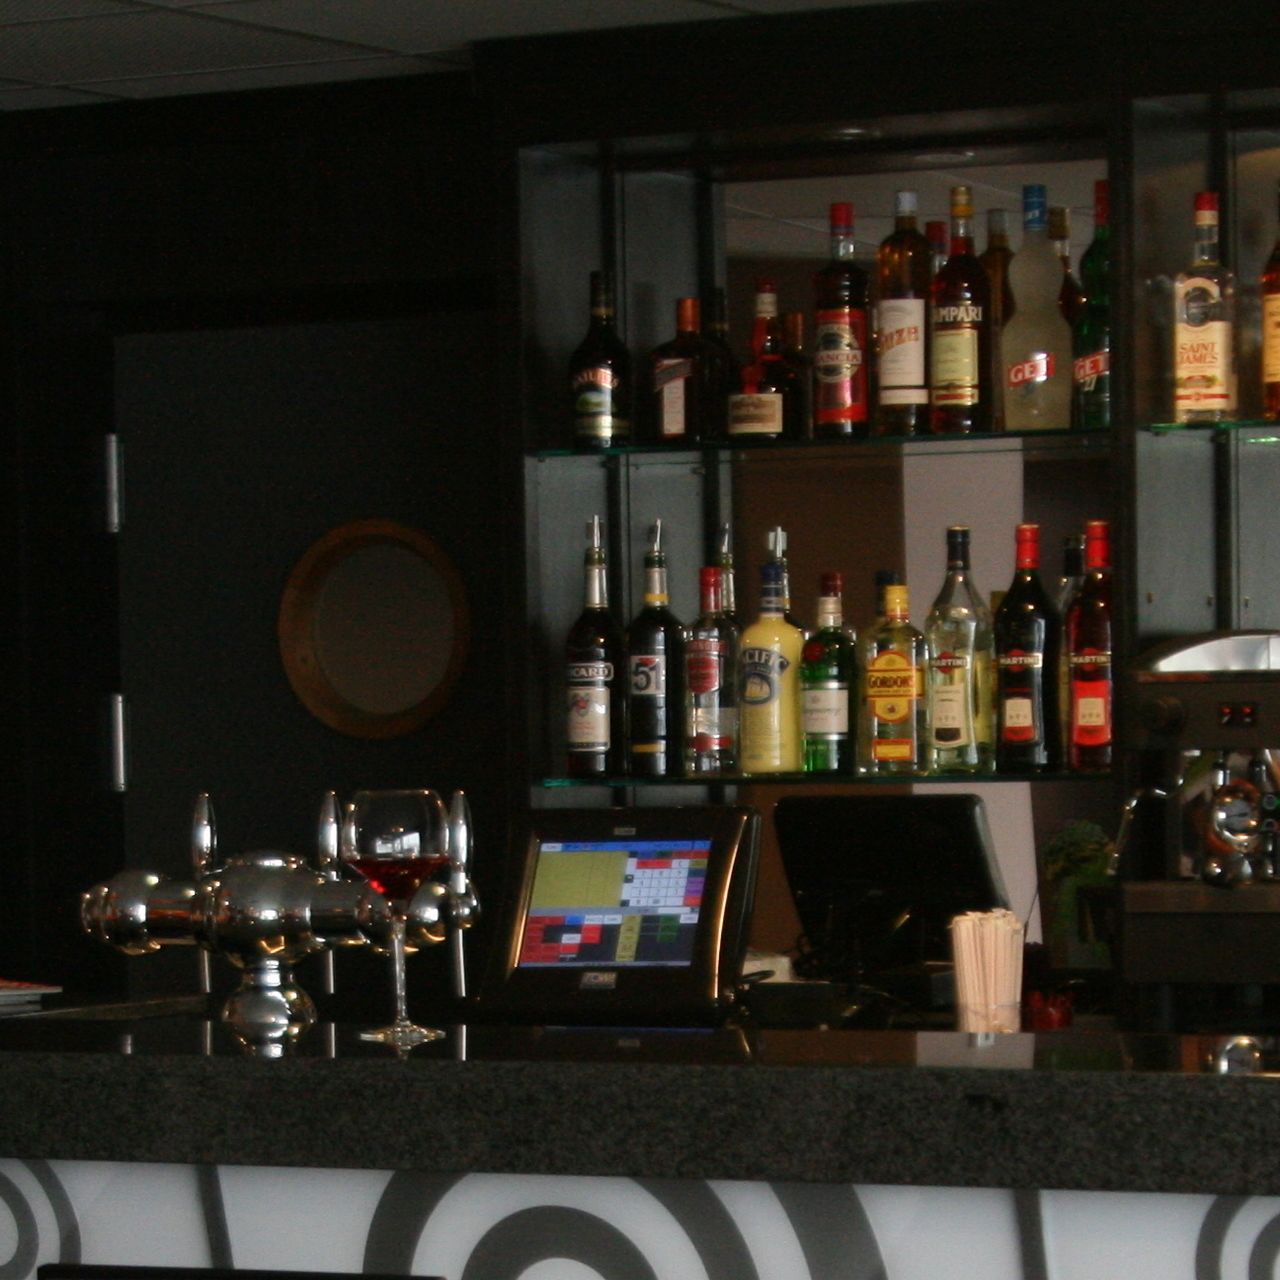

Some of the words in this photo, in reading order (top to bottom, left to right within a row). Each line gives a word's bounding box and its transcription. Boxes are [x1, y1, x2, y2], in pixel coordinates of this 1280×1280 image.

[931, 305, 982, 321] AMPARI
[1180, 343, 1212, 353] SAINT
[1179, 353, 1216, 364] JAMES
[930, 658, 968, 668] MARTINI
[999, 656, 1040, 666] MARTINI
[1071, 655, 1110, 665] MARTINI
[633, 663, 662, 691] 51
